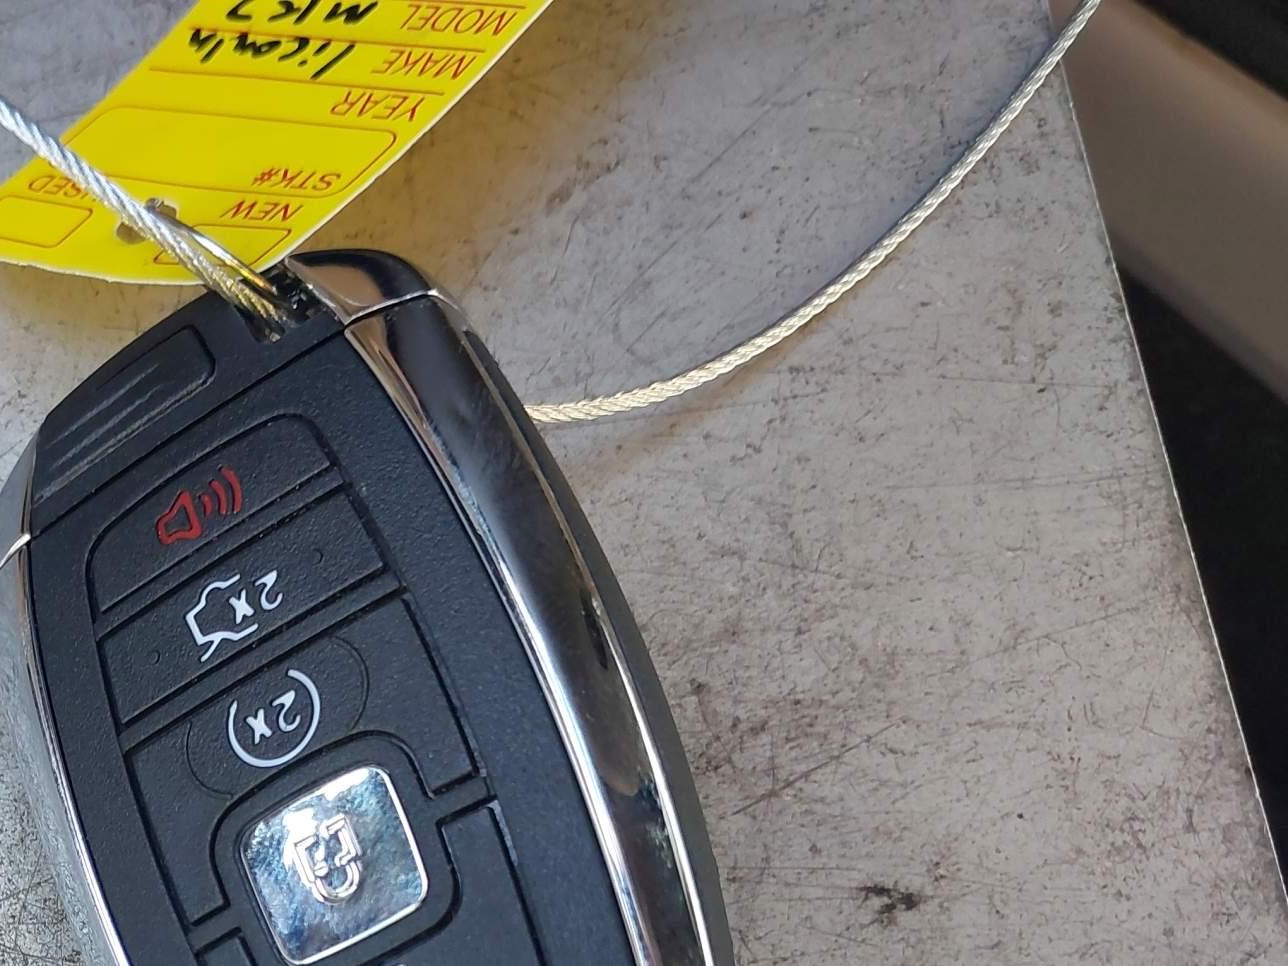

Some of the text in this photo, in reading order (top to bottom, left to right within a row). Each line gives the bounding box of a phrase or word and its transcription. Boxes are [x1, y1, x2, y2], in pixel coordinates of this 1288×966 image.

[400, 4, 517, 36] MODEL
[370, 49, 477, 80] MAKE
[330, 90, 425, 122] YEAR
[28, 174, 98, 202] SED
[251, 167, 342, 191] STK#
[220, 199, 304, 222] NEW
